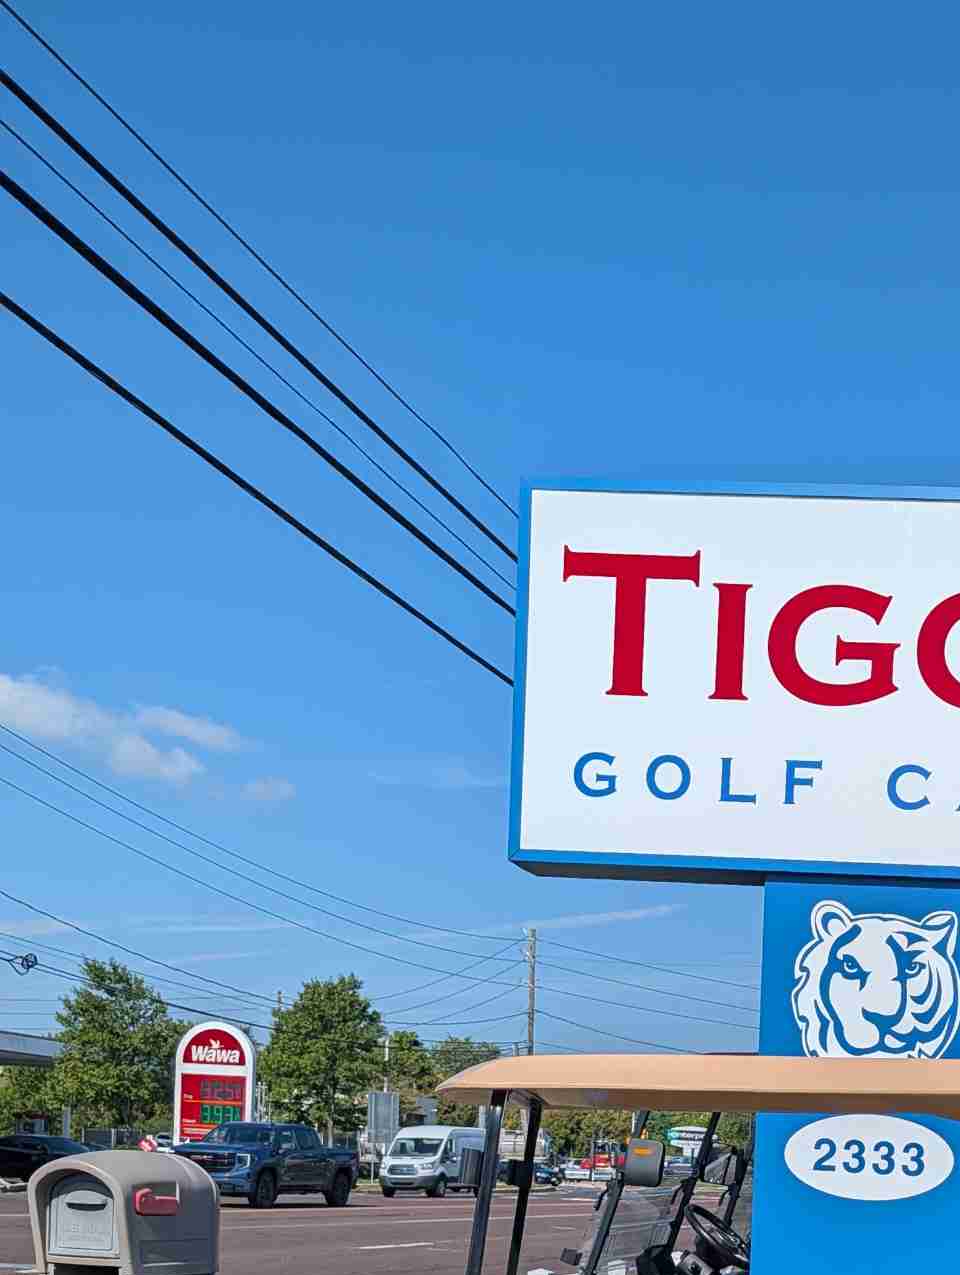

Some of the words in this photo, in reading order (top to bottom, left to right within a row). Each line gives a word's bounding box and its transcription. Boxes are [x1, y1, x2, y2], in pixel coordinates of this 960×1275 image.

[574, 751, 823, 805] GOLF
[191, 1044, 240, 1064] Wawa
[812, 1137, 926, 1177] 2333
